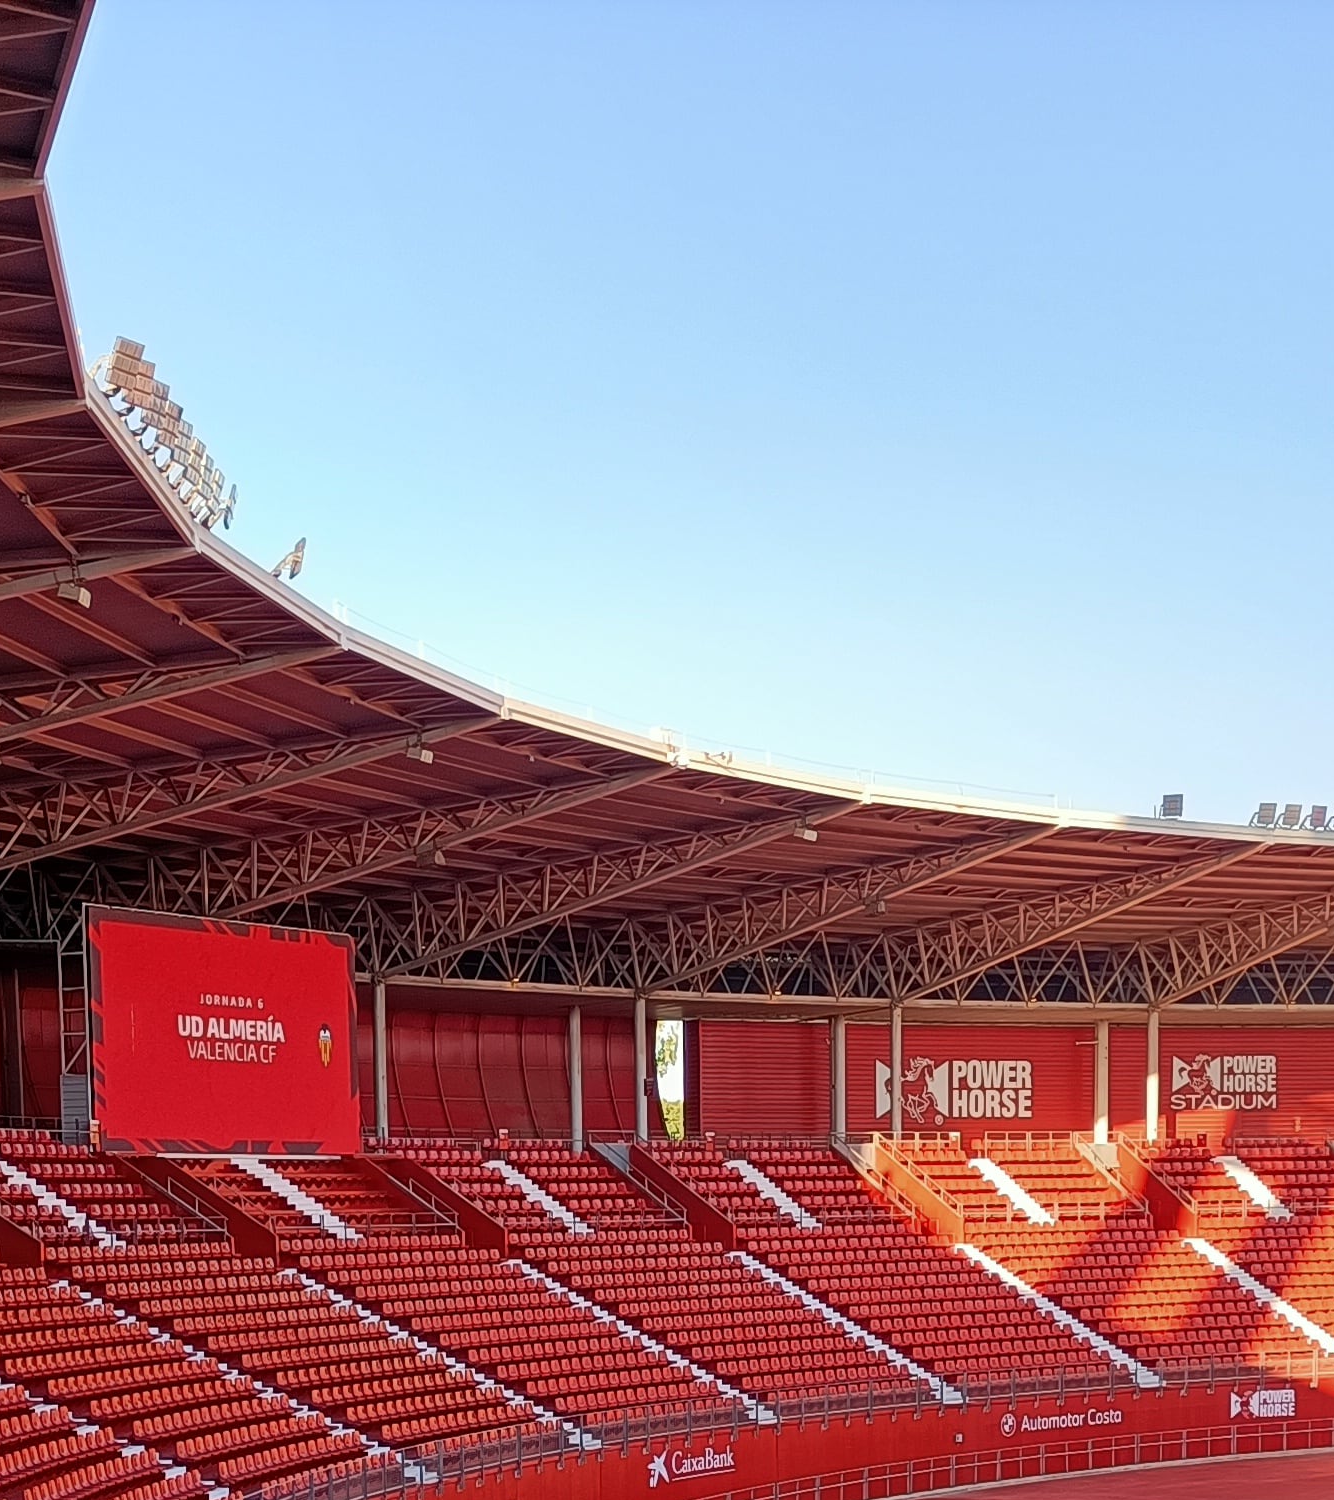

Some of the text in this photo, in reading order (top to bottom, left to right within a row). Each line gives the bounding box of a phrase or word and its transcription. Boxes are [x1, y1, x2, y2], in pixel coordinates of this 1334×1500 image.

[200, 993, 265, 1010] JORNADA 6
[177, 1014, 286, 1043] UD ALMERÍA
[187, 1040, 277, 1064] VALENCIA CF
[952, 1060, 1033, 1089] POWER
[1223, 1055, 1277, 1074] POWER
[1223, 1074, 1277, 1093] HORSE
[952, 1089, 1033, 1118] HORSE
[1170, 1094, 1277, 1110] STADIUM
[1259, 1389, 1295, 1404] POWER
[1021, 1408, 1122, 1432] Automotor Costa
[1259, 1402, 1296, 1417] HORSE
[671, 1444, 734, 1474] CaixaBank
